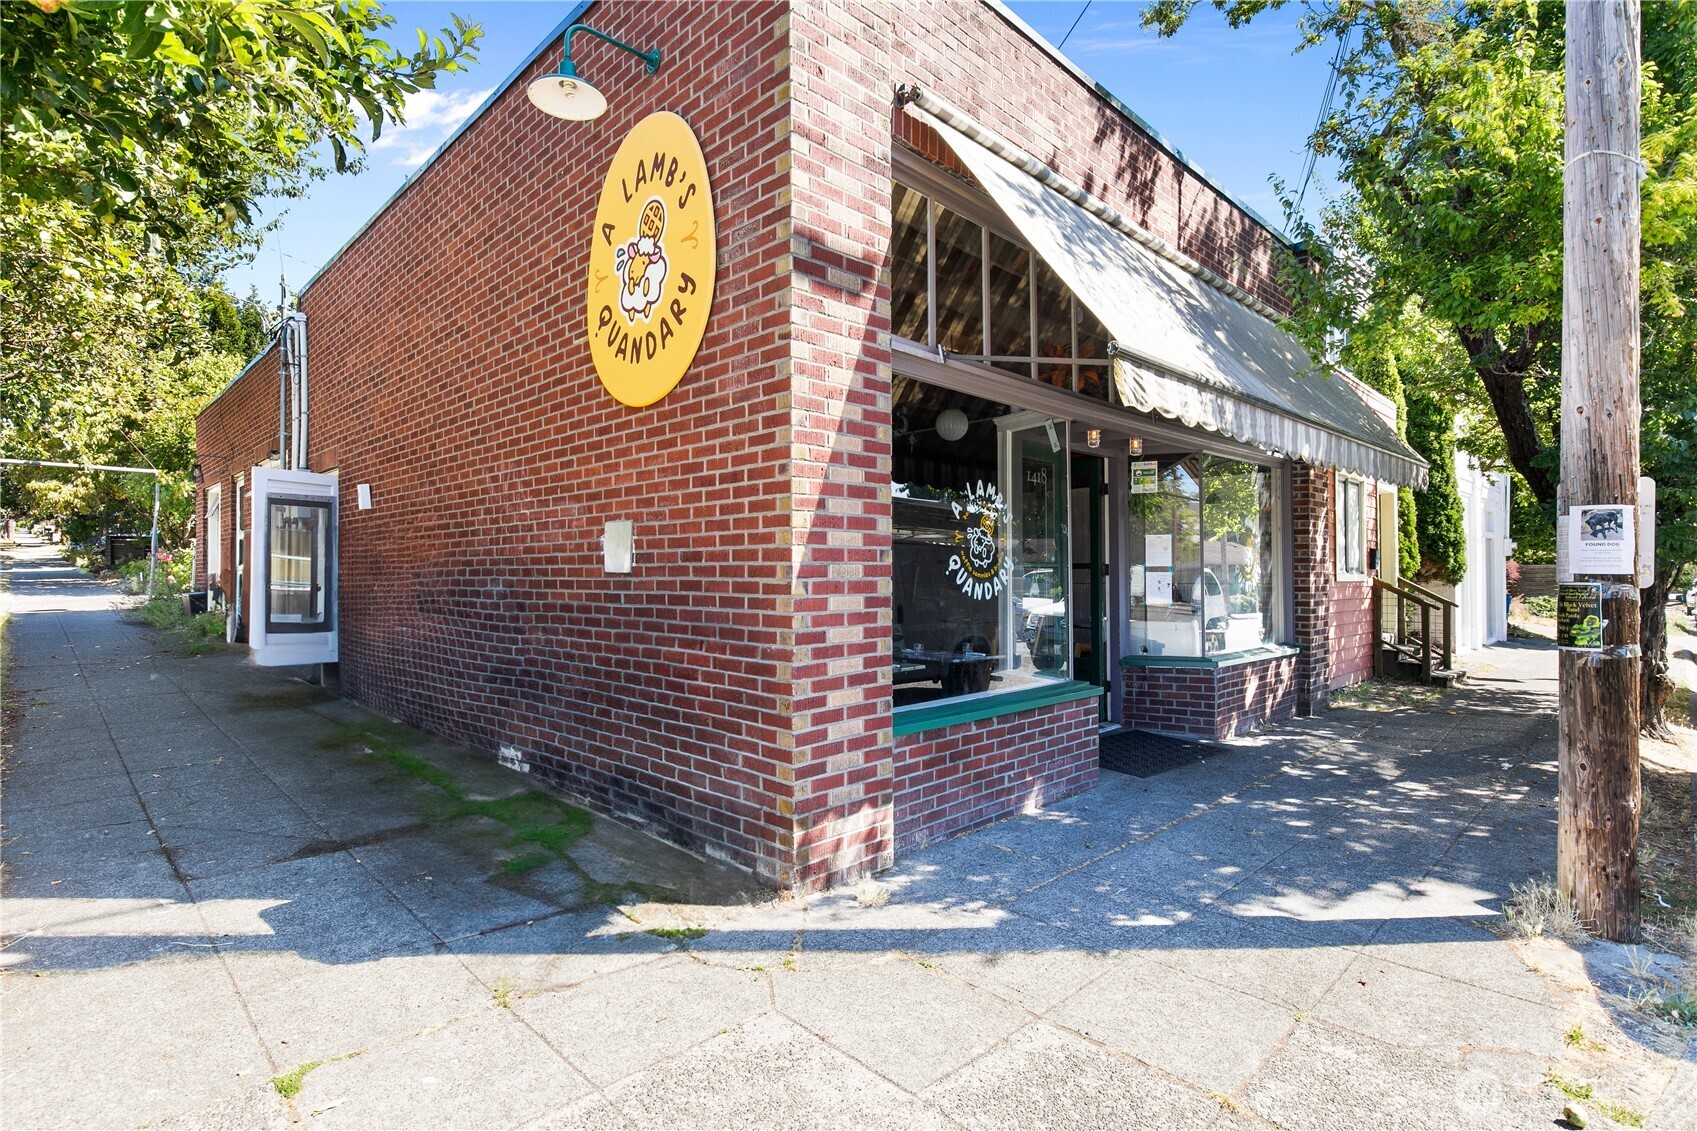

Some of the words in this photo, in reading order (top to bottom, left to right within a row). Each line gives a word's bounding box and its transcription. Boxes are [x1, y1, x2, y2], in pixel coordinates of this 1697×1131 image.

[602, 223, 616, 246] A
[621, 151, 697, 210] LAMB'S
[595, 272, 697, 364] QUANDARY
[1026, 467, 1048, 486] 1418
[950, 501, 963, 520] A
[945, 555, 1015, 600] QUANDARY
